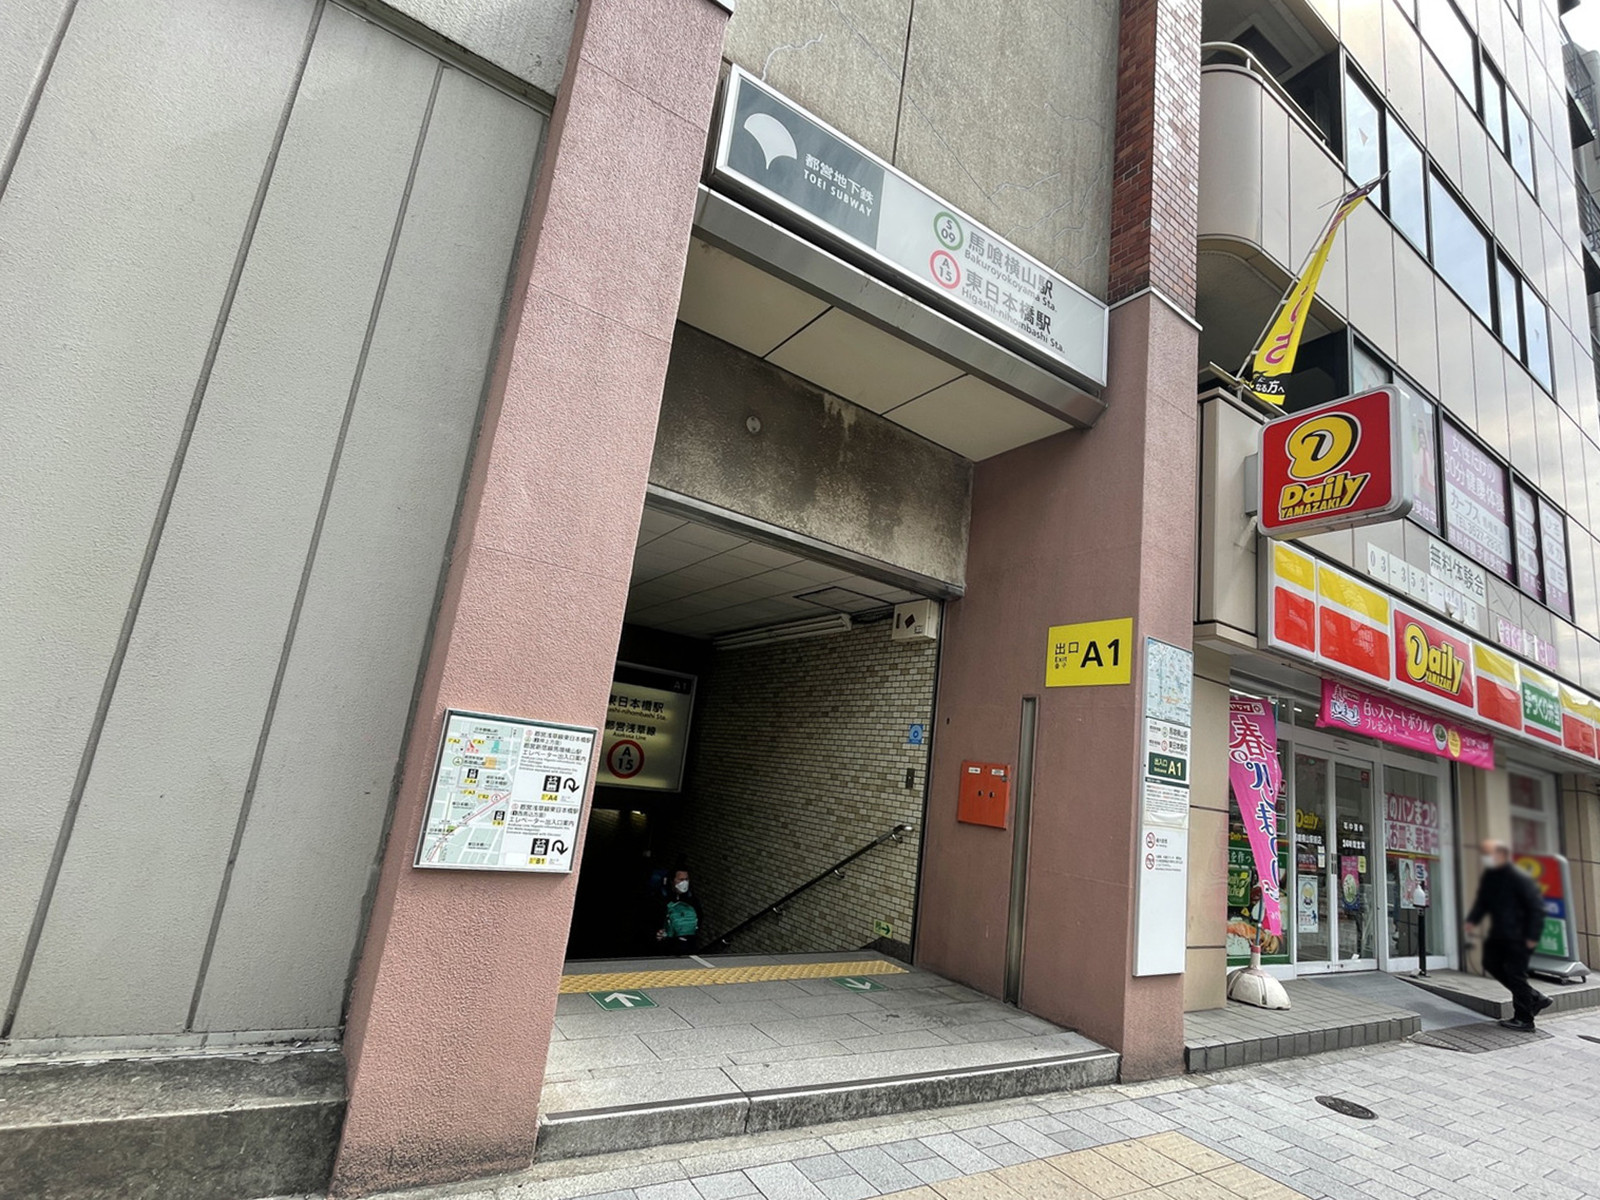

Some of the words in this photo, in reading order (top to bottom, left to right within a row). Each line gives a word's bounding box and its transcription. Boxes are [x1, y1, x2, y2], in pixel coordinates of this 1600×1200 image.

[804, 153, 874, 205] 都営地下鉄
[803, 169, 827, 191] TOEI
[830, 186, 872, 217] SUBWAY
[945, 219, 953, 229] S
[941, 228, 956, 243] 09
[941, 257, 951, 268] A
[968, 231, 1053, 300] 馬喰横山駅
[938, 266, 953, 282] 15
[965, 268, 1052, 335] 東日本橋駅
[1281, 471, 1369, 508] Daily
[1280, 497, 1341, 519] YAMAZAKI
[1430, 544, 1485, 598] 無料体験会
[1055, 641, 1080, 656] 出口
[1080, 638, 1120, 668] A1
[1404, 623, 1465, 694] Daily
[622, 746, 631, 757] A
[618, 758, 634, 771] 15
[1168, 760, 1182, 777] A1
[1295, 809, 1320, 829] Daily
